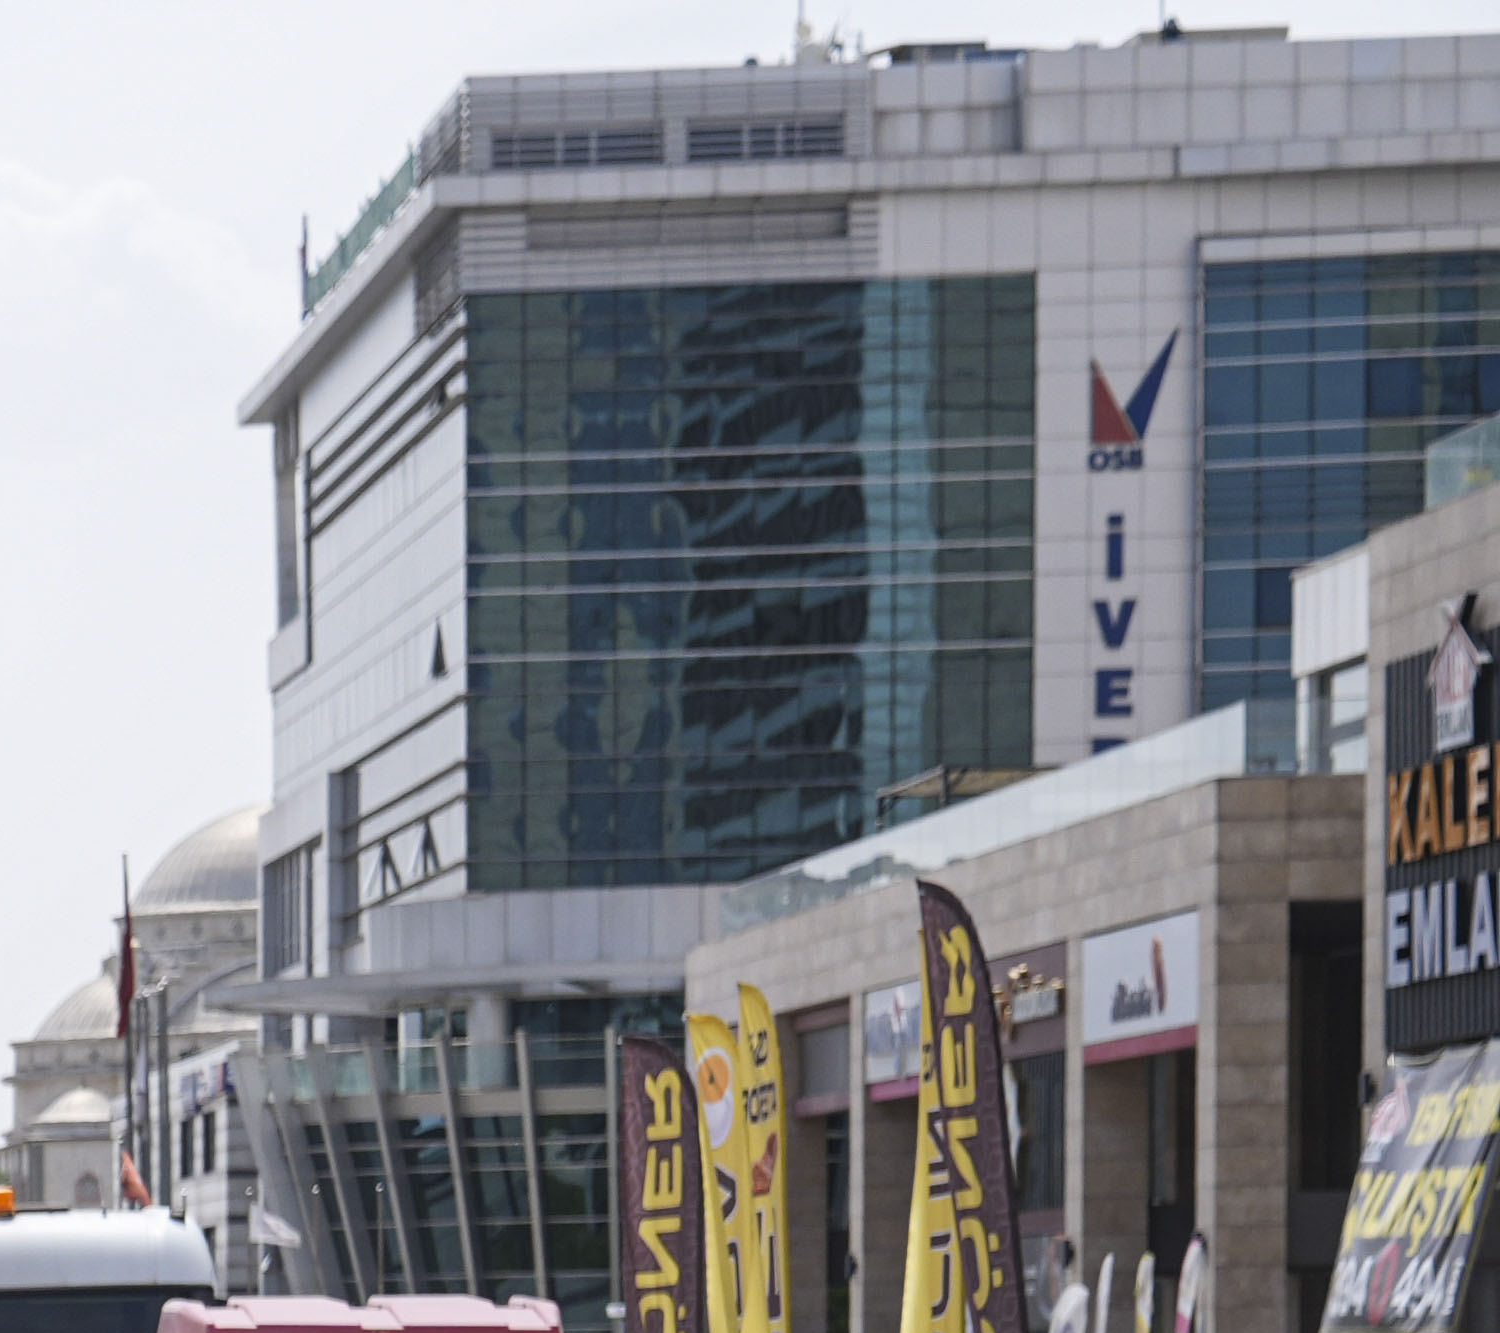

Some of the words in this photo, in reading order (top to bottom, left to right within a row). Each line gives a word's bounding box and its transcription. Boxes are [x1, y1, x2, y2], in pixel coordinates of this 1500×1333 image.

[1093, 513, 1137, 756] İVE
[1388, 740, 1500, 867] KALE
[1386, 870, 1500, 990] EMLA
